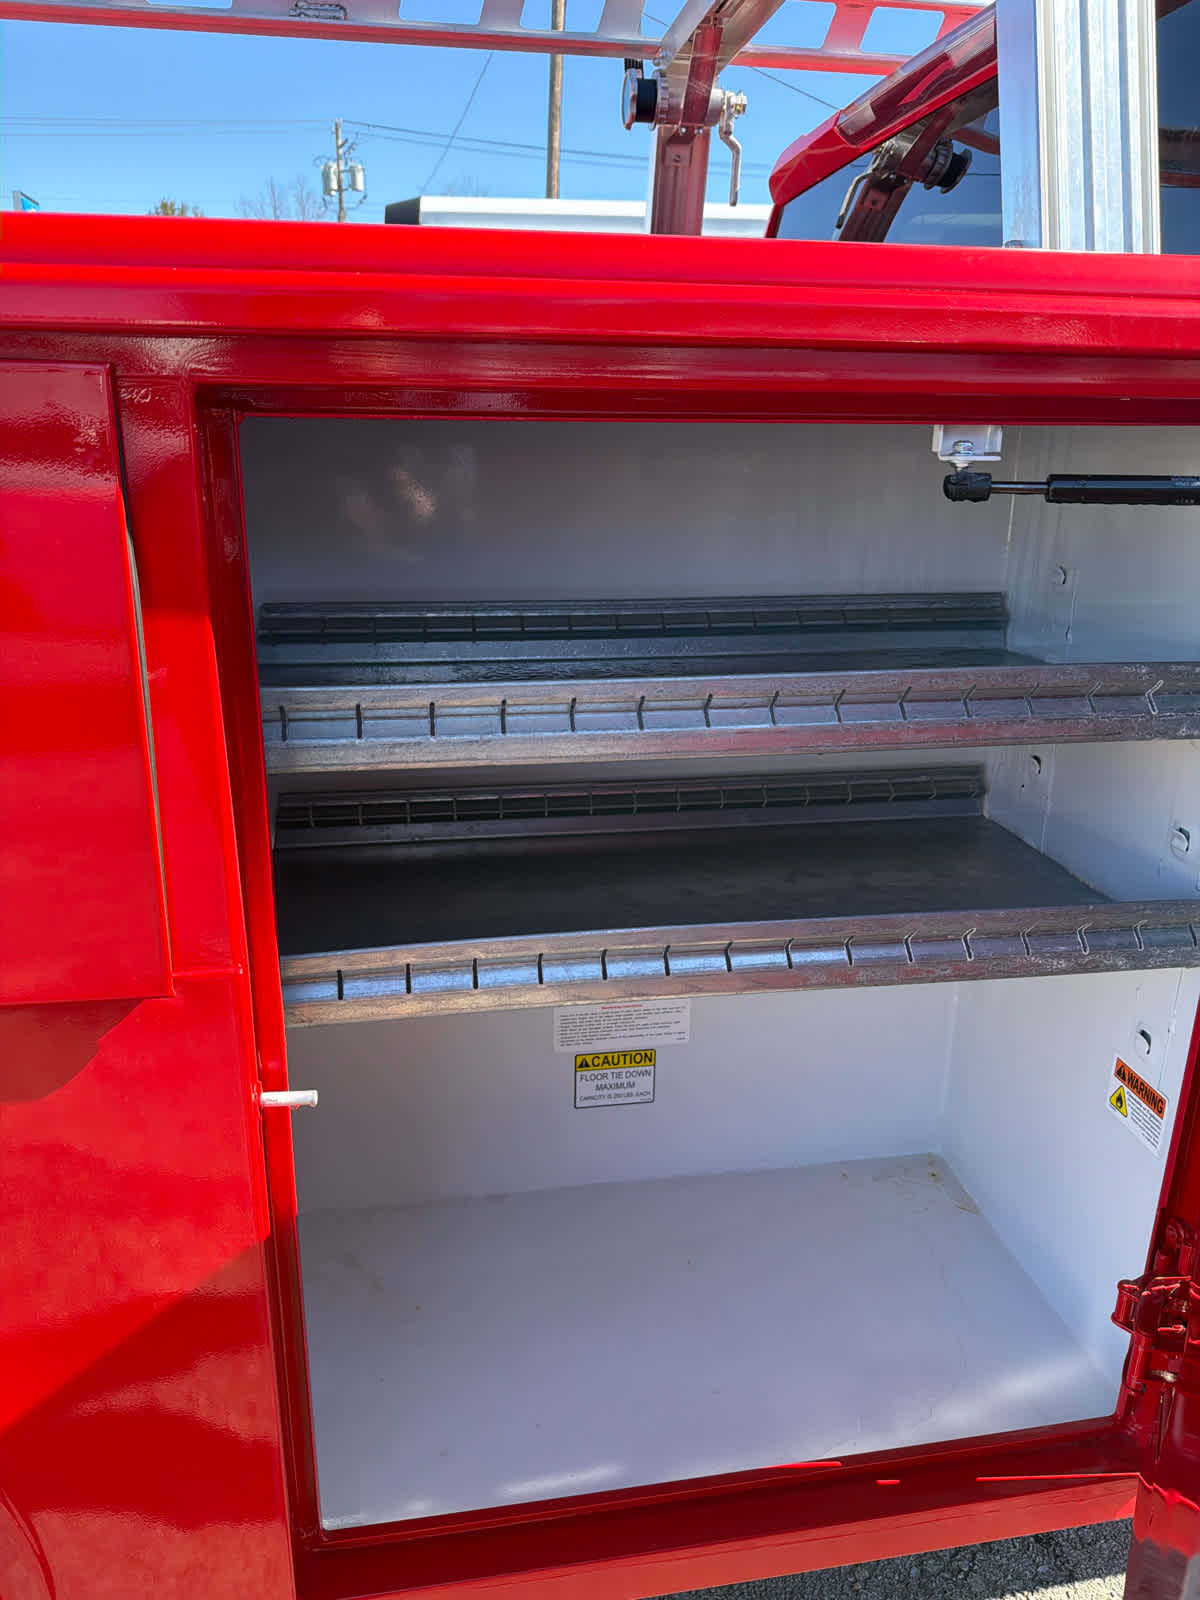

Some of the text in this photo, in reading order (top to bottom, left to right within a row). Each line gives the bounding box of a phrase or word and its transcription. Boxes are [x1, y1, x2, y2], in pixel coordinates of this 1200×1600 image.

[591, 1052, 653, 1067] CAUTION
[580, 1069, 651, 1082] FLOOR TIE DOWN
[595, 1081, 636, 1091] MAXIMUM
[1127, 1072, 1164, 1114] WARNING
